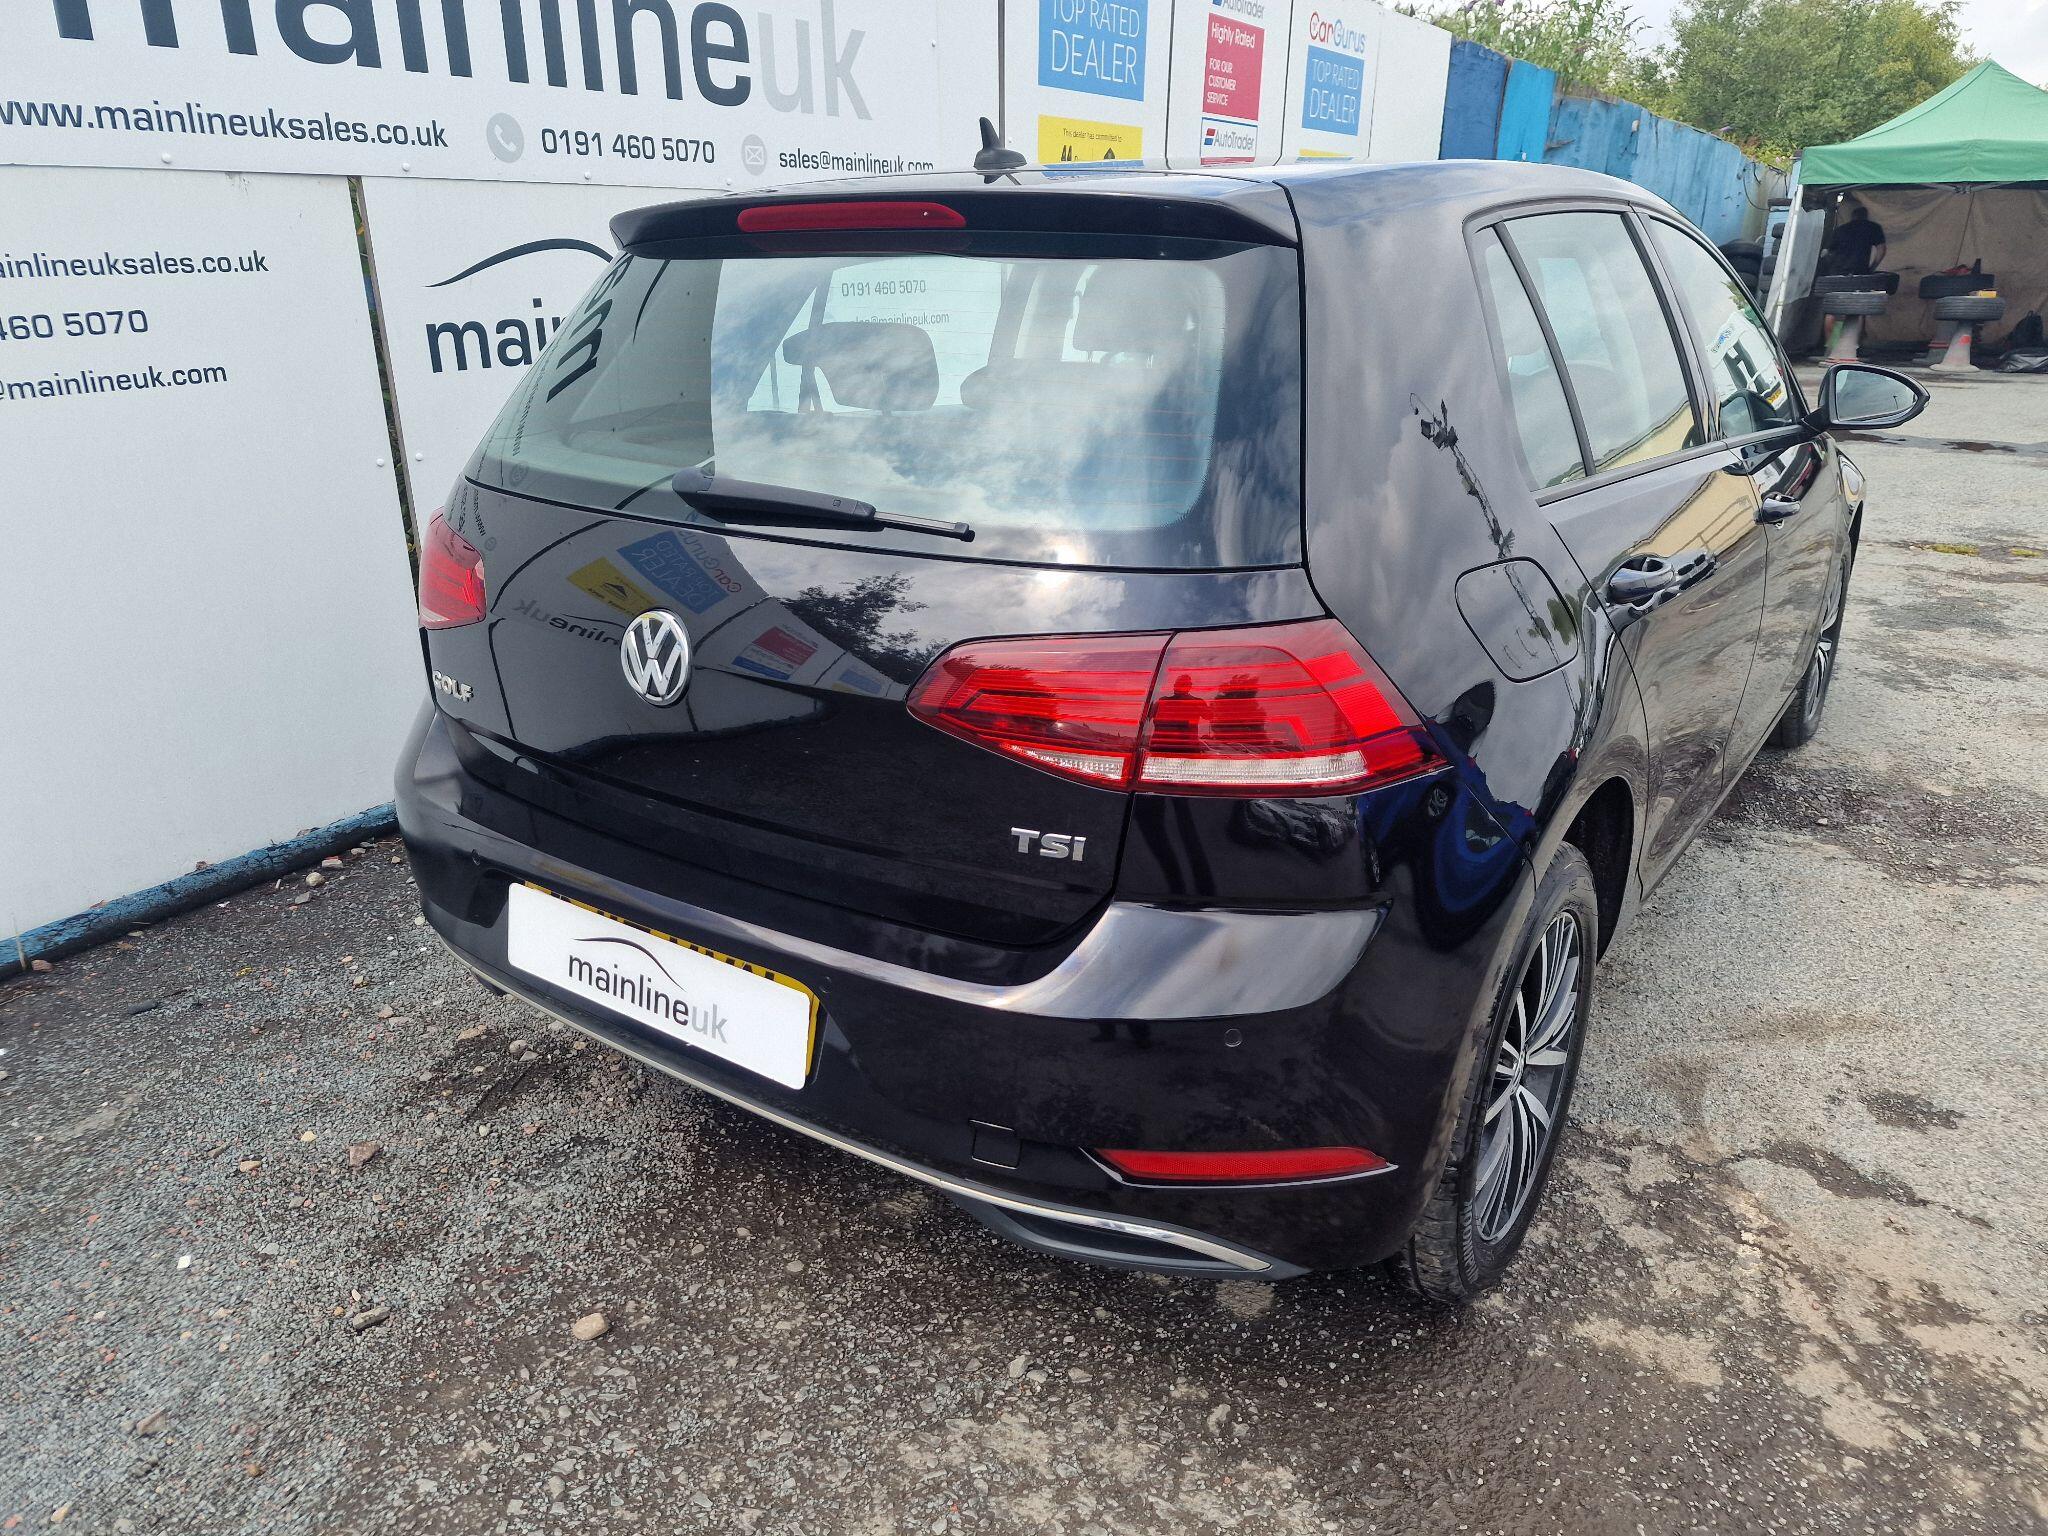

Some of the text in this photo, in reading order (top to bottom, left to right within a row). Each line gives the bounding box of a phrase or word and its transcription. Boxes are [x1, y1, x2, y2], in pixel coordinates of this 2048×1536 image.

[1090, 0, 1140, 38] RATED
[1309, 11, 1366, 54] CarGurus
[1211, 22, 1256, 48] Highly Rated
[1051, 29, 1137, 85] DEALER
[1208, 58, 1233, 74] FOR OUR
[1208, 75, 1237, 91] CUSTOMER
[1311, 59, 1360, 90] TOP RATED
[1206, 92, 1229, 106] SERVICE
[1309, 88, 1357, 124] DEALER
[541, 128, 715, 163] 0191 460 5070
[1213, 131, 1255, 150] AutoTrader
[779, 148, 934, 174] sales@mainlineukcom
[841, 279, 926, 297] 0191 460 5070
[62, 309, 149, 336] 5070
[425, 297, 562, 373] mai
[0, 364, 228, 401] mainlineuk.com
[432, 670, 474, 702] GOLF
[568, 954, 729, 1044] mainlineuk
